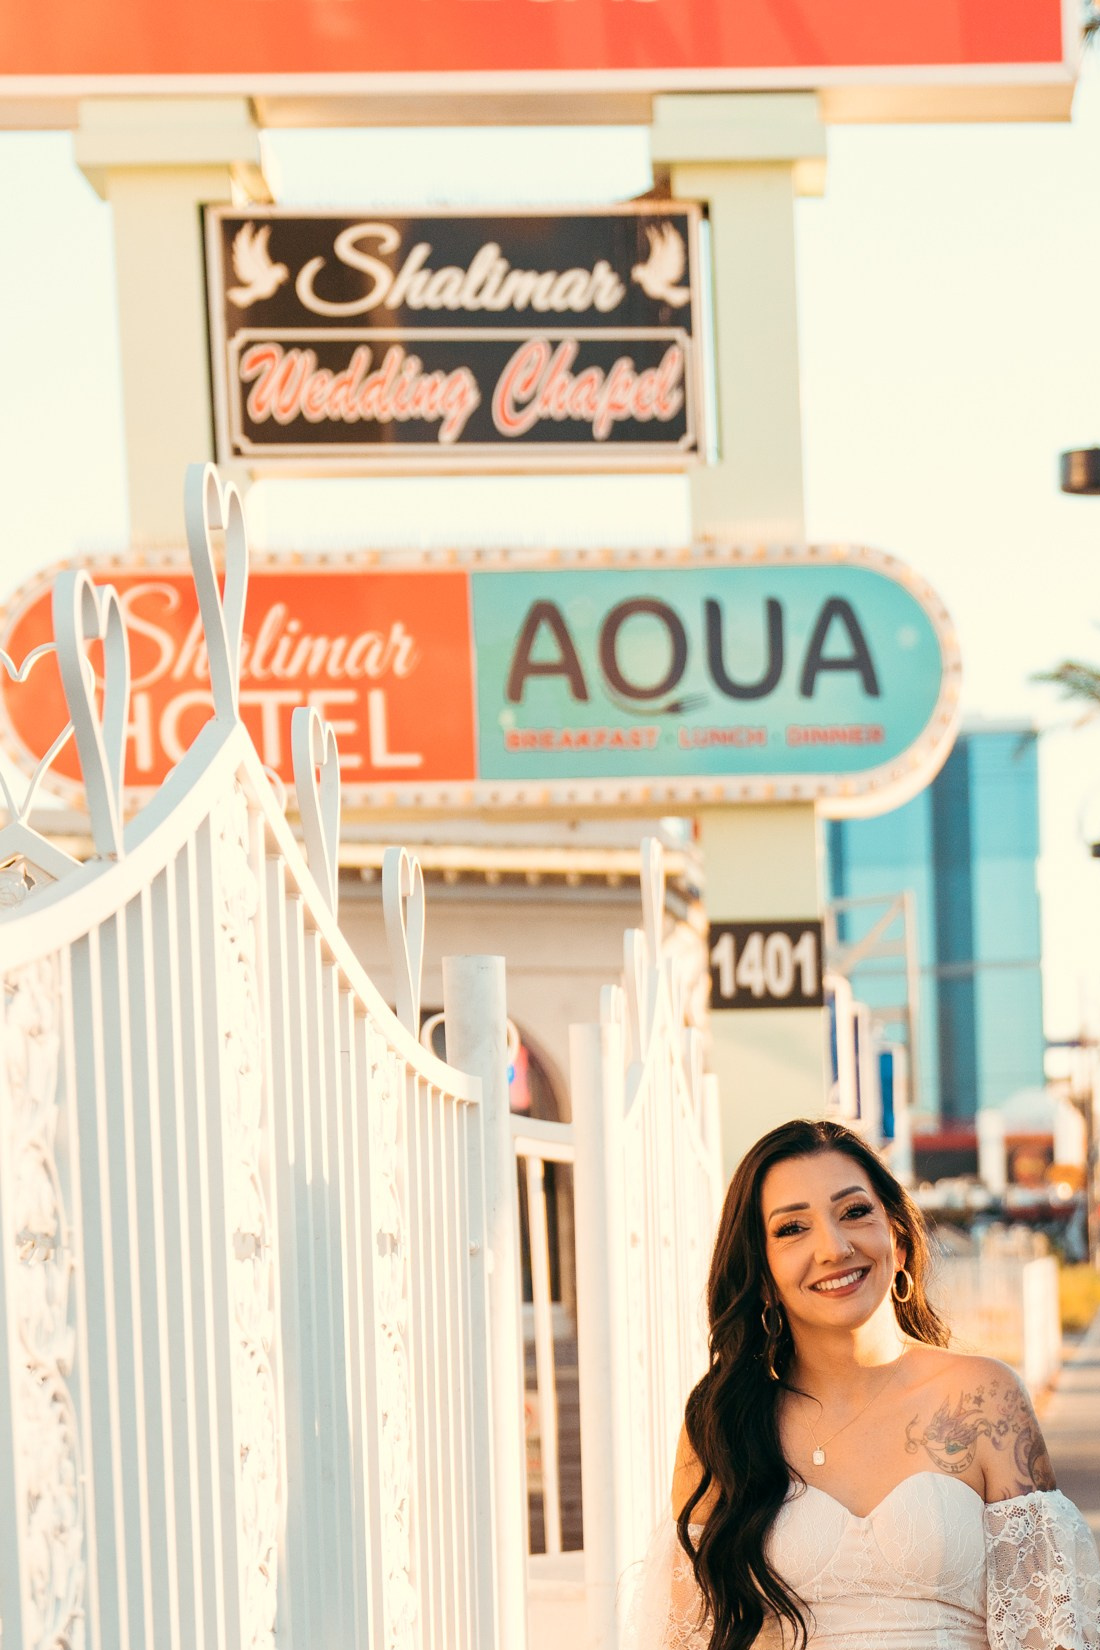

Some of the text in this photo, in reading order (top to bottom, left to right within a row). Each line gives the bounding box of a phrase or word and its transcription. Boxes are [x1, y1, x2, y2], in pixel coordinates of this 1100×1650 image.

[296, 222, 626, 318] Shalimar
[240, 336, 686, 444] Wedding Chapel
[505, 594, 882, 705] AQUA
[505, 723, 885, 753] BREAKFAST LUNCH DINNER
[710, 930, 818, 999] 1401
